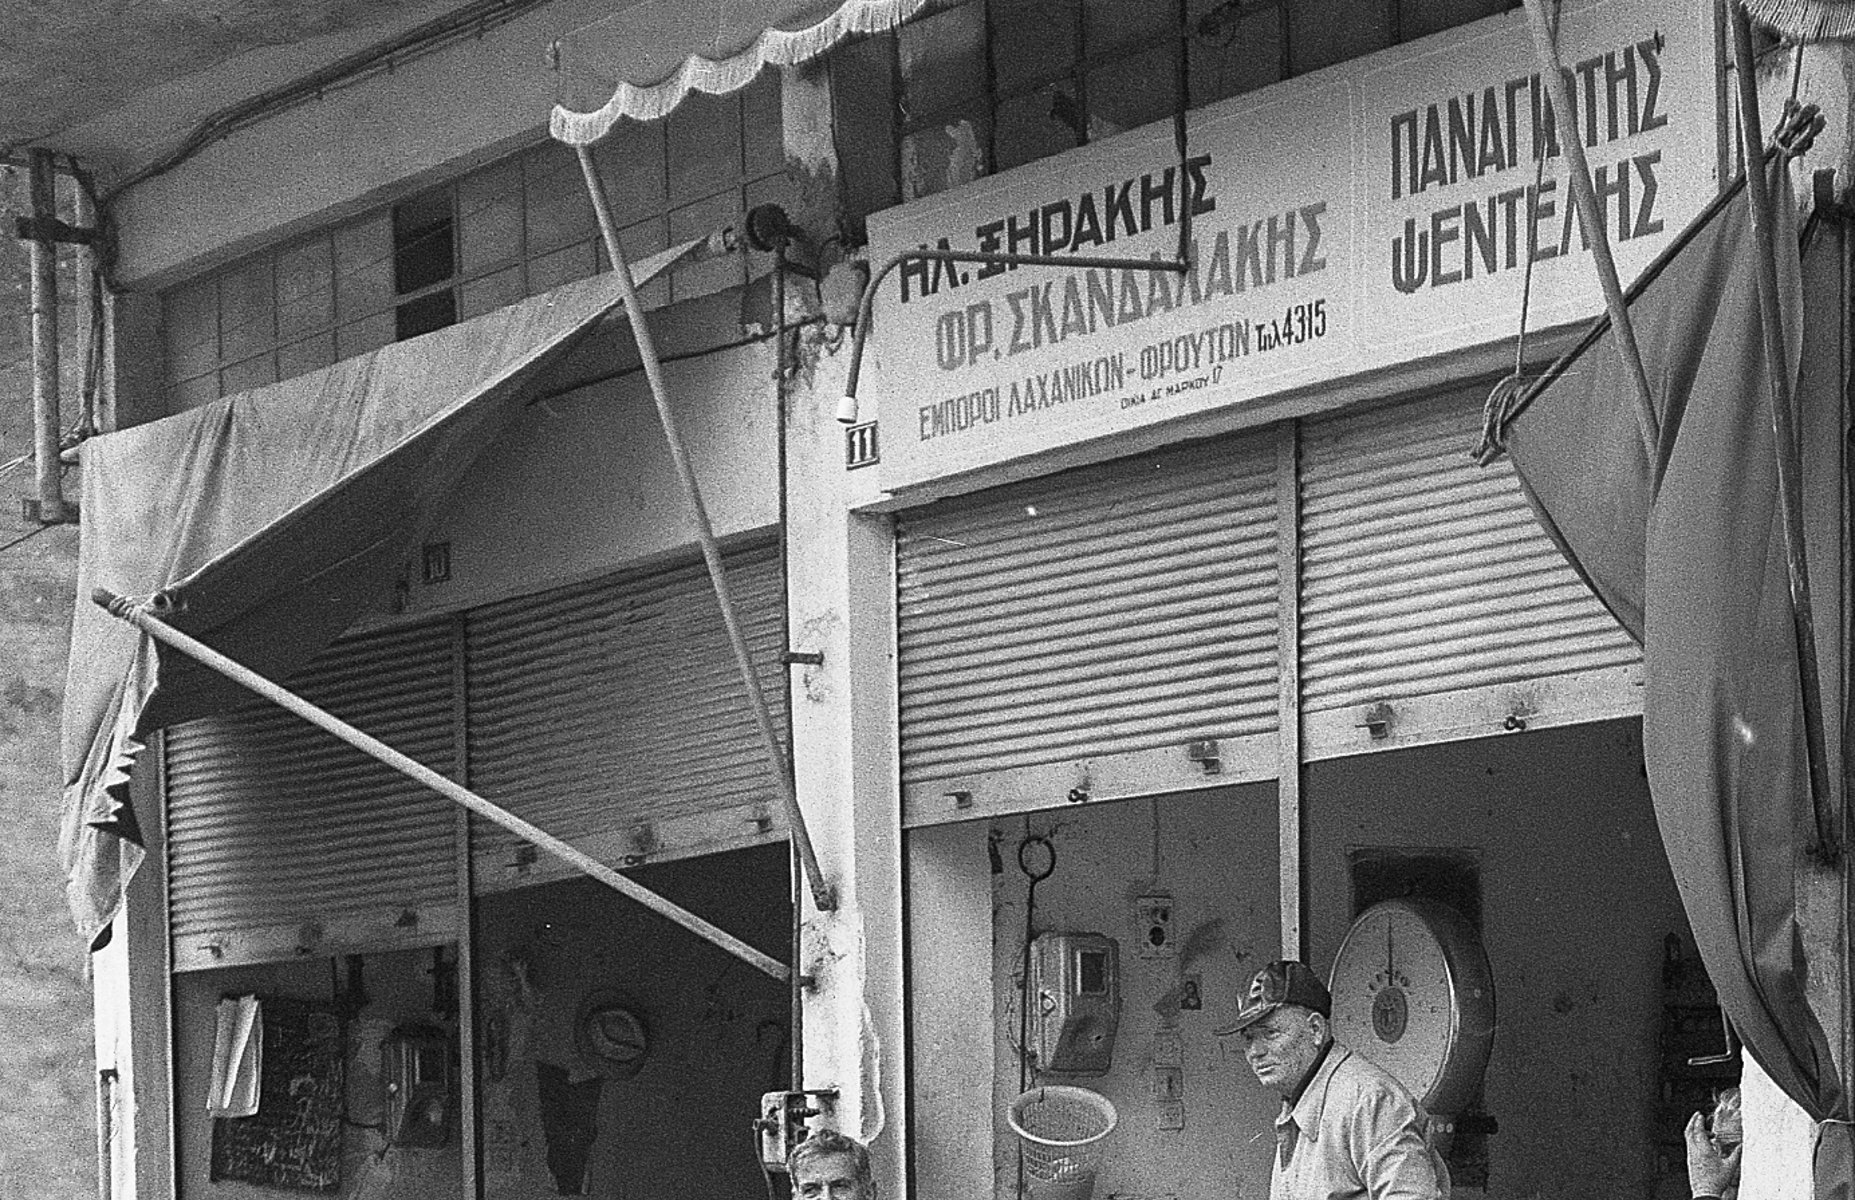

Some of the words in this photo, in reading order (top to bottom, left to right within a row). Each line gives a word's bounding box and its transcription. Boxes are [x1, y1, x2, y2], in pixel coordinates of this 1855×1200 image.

[1390, 36, 1668, 201] ΠΑΝΑΓΙΩΤΗΣ
[975, 153, 1217, 281] ΞΗΡΑΚΗΣ
[1391, 149, 1665, 294] ΨΕΝΤΕΛΗΣ
[935, 300, 1000, 371] ΦΡ.
[1004, 200, 1327, 357] ΣΚΑΝΔΑΛΑΚΗΣ
[849, 426, 875, 464] 11
[918, 386, 1000, 442] ΕΜΠΟΡΟΙ
